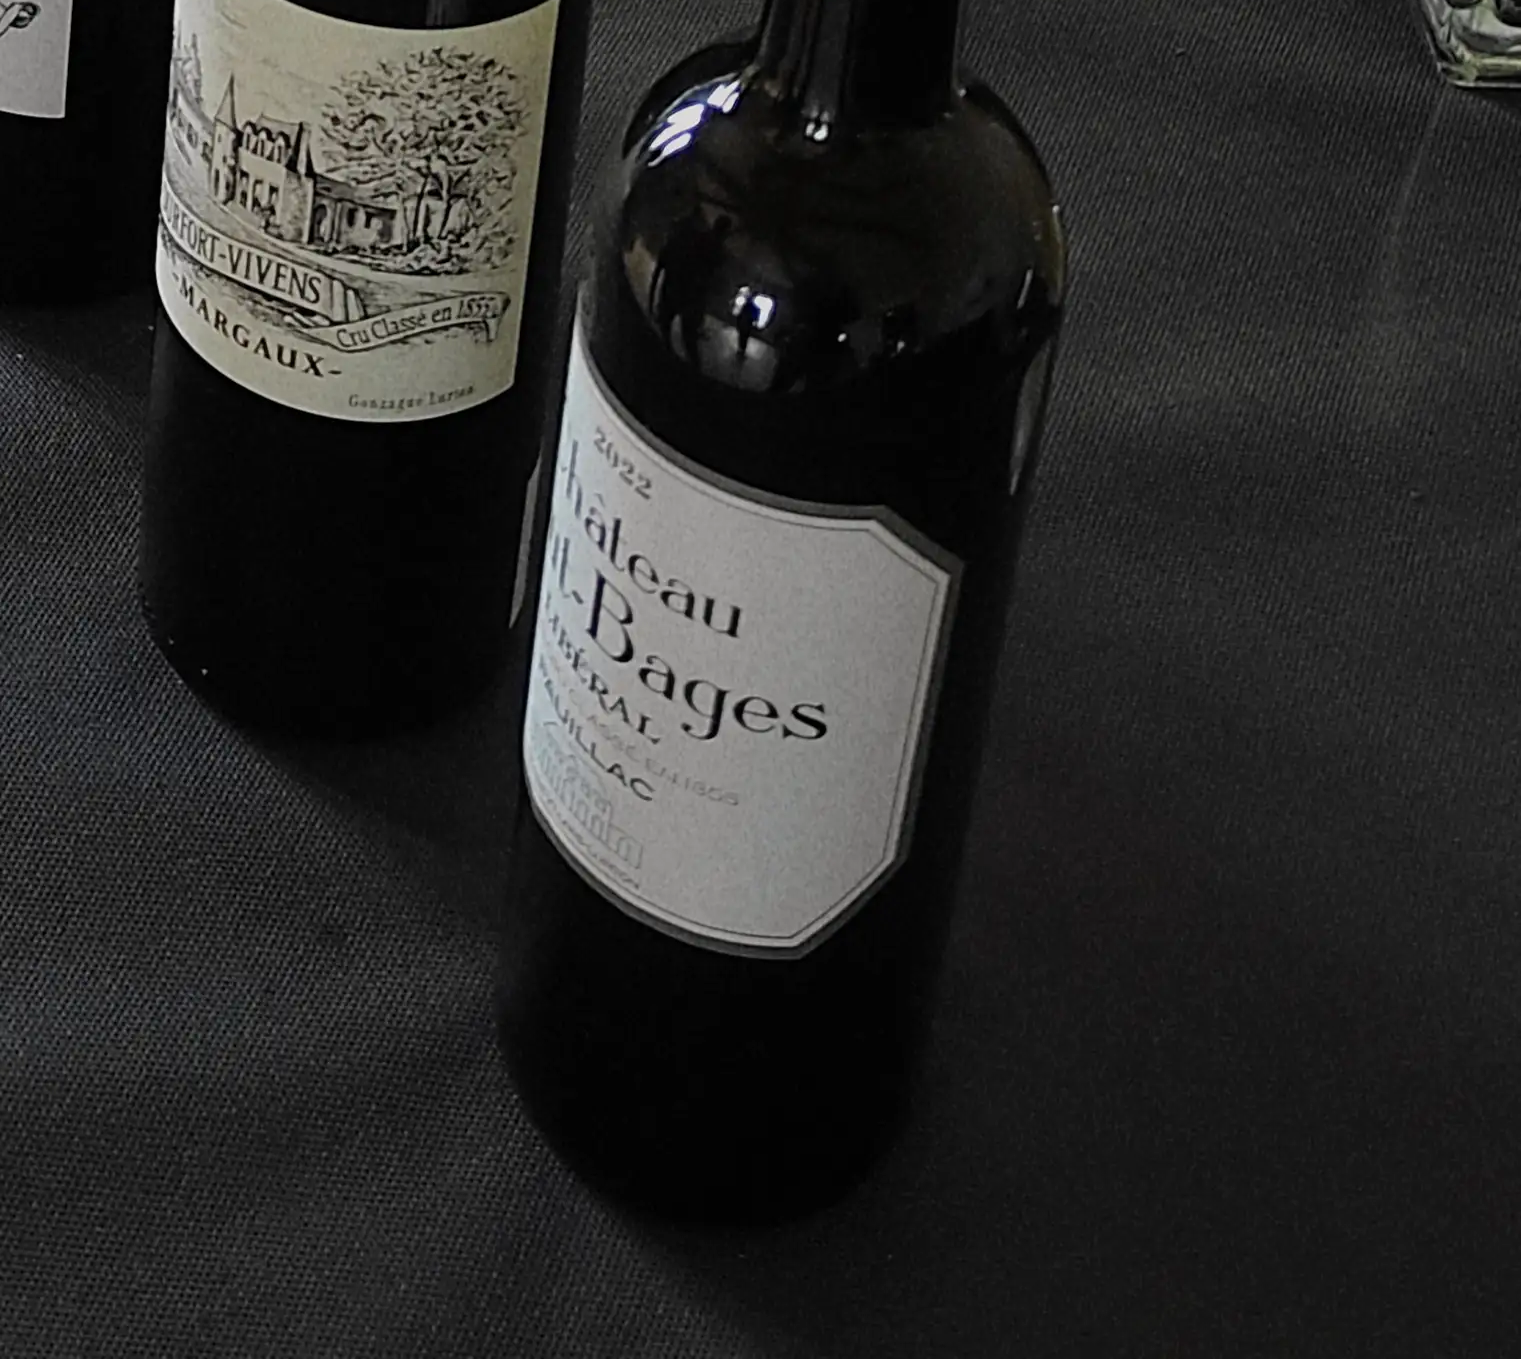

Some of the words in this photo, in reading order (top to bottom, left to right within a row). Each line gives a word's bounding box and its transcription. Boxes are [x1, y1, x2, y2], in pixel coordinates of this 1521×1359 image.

[336, 328, 370, 348] Cru
[431, 306, 452, 323] en
[560, 437, 743, 639] hâteau
